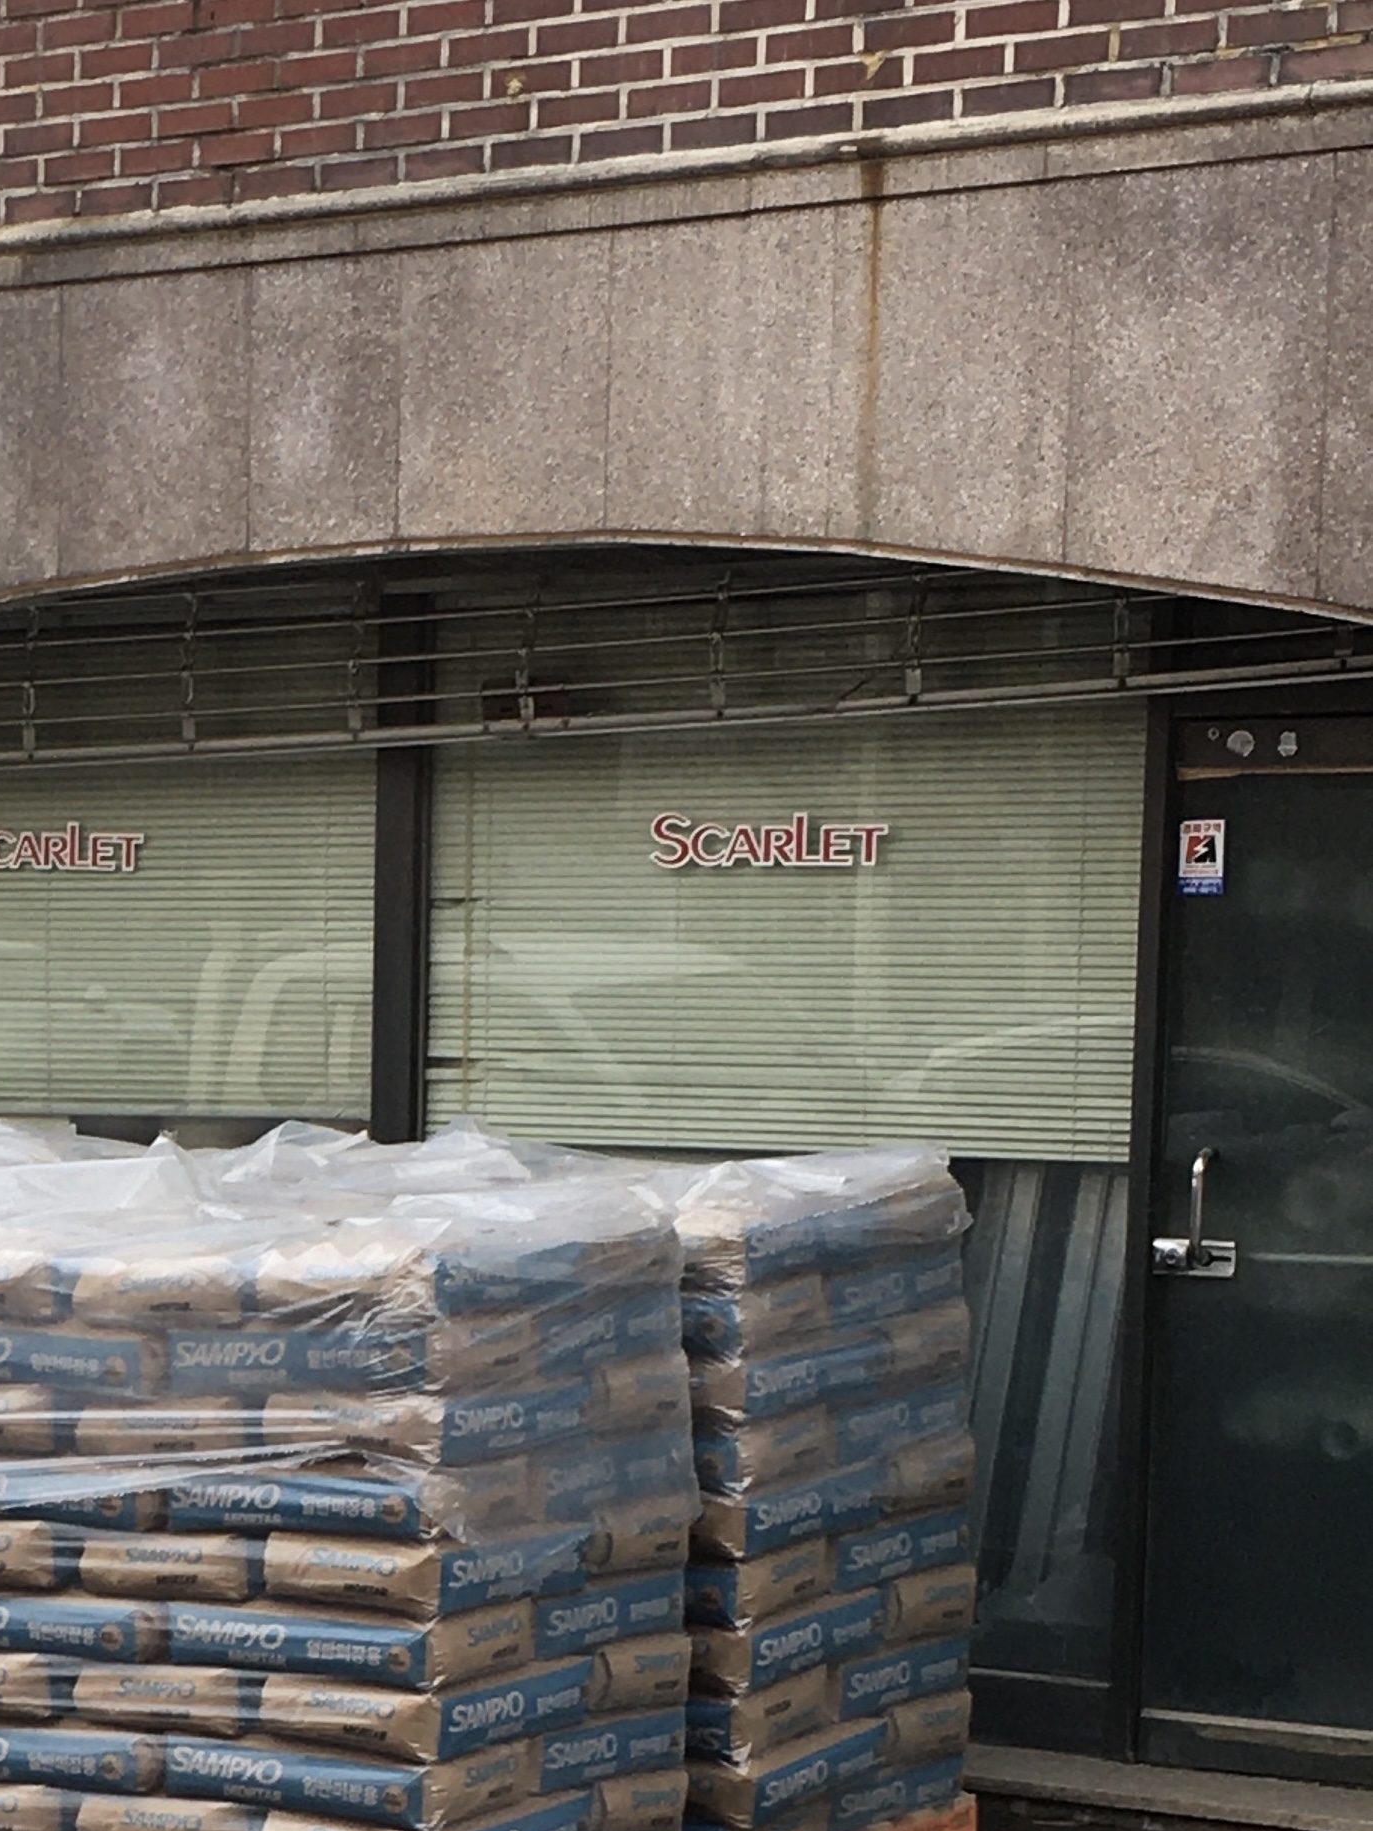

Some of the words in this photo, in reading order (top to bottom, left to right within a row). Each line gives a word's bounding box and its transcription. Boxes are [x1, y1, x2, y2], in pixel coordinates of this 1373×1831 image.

[649, 812, 889, 868] SCARLET
[173, 1338, 286, 1367] SAMPYO
[451, 1402, 524, 1436] SAMPYO
[171, 1482, 281, 1509] SAMPYO
[449, 1551, 523, 1588] SAMPYO
[176, 1614, 287, 1650] SAMPYO
[546, 1597, 617, 1637] SAMPYO
[449, 1691, 525, 1733] SAMPYO
[169, 1745, 283, 1785] SAMPYO
[544, 1733, 618, 1769] SAMPYO
